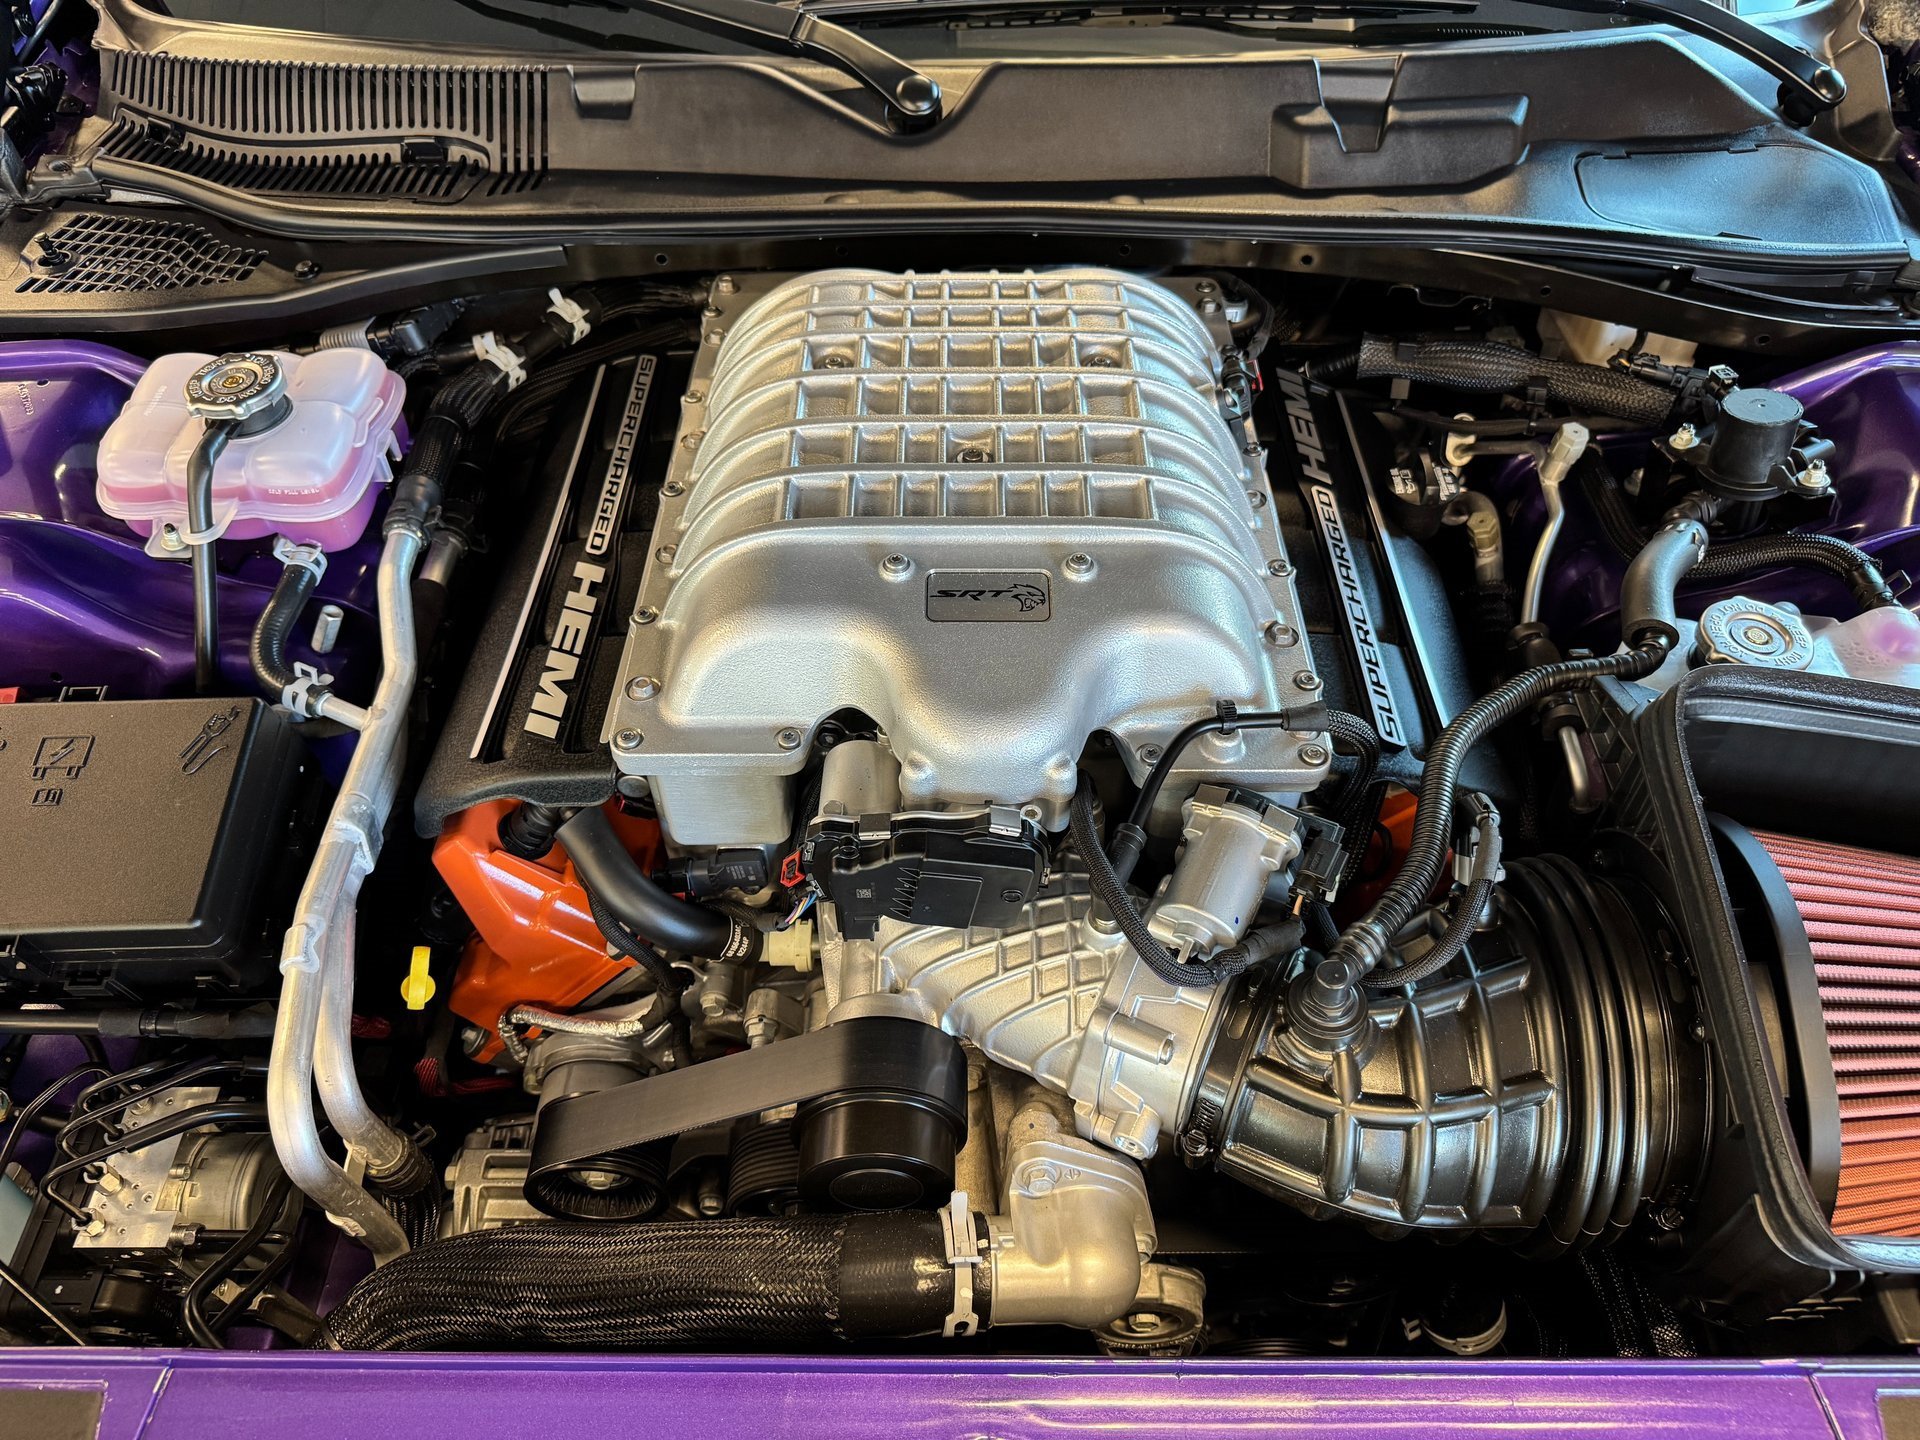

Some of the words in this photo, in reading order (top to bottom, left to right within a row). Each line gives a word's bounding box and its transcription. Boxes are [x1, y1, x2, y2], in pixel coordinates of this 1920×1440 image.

[588, 355, 656, 554] SUPERCHARGED
[1277, 367, 1332, 485] HEMI
[1313, 488, 1402, 744] SUPERCHARGED
[930, 589, 1014, 601] SRT
[1719, 603, 1743, 617] NOT
[1744, 603, 1765, 614] DO
[1709, 613, 1724, 639] OPEN
[1784, 622, 1808, 649] KEEP
[523, 561, 605, 739] HEMI
[1772, 651, 1806, 667] TIGHT
